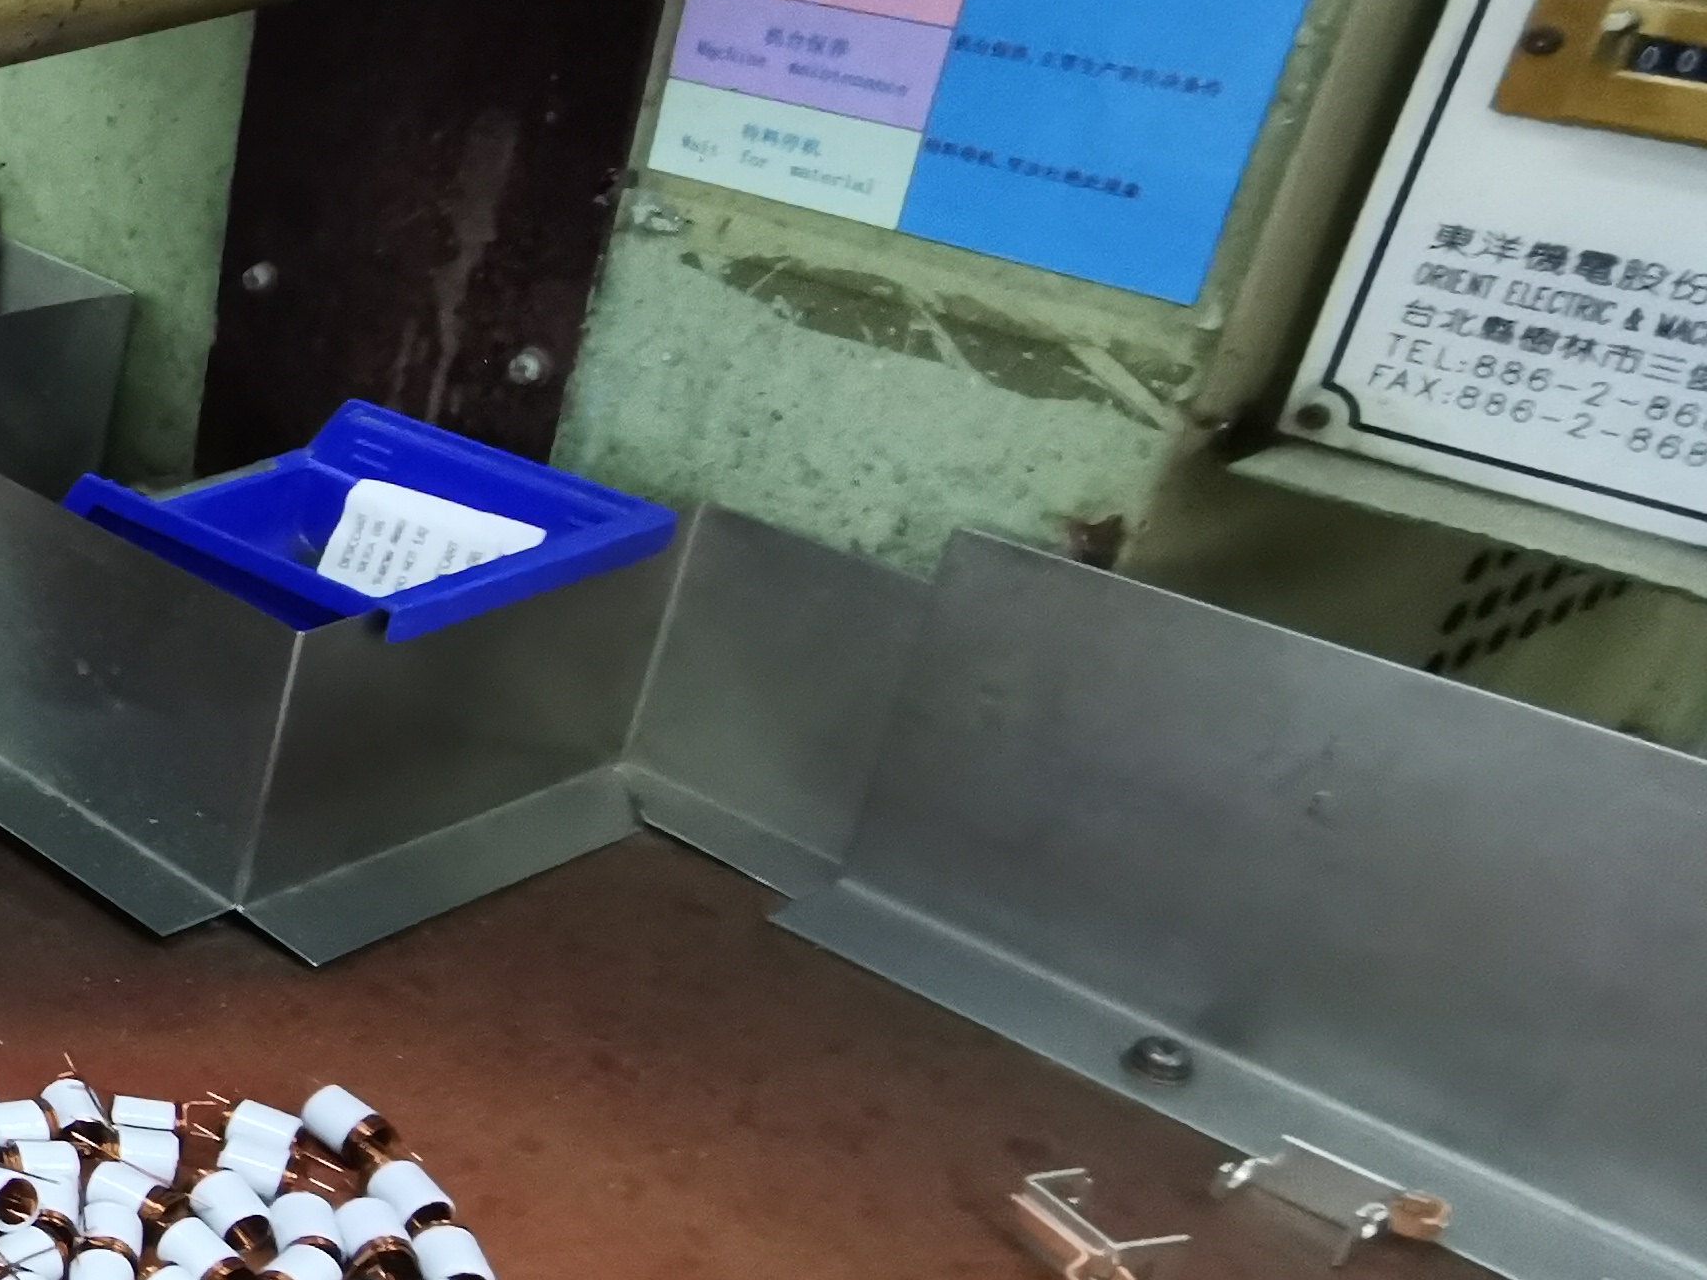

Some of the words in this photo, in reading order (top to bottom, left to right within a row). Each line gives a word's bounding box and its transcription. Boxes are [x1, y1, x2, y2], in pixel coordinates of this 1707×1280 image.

[1414, 261, 1501, 300] ORIENT
[1502, 279, 1619, 326] ELECTRIC
[1387, 331, 1707, 429] TEL:886-2-86
